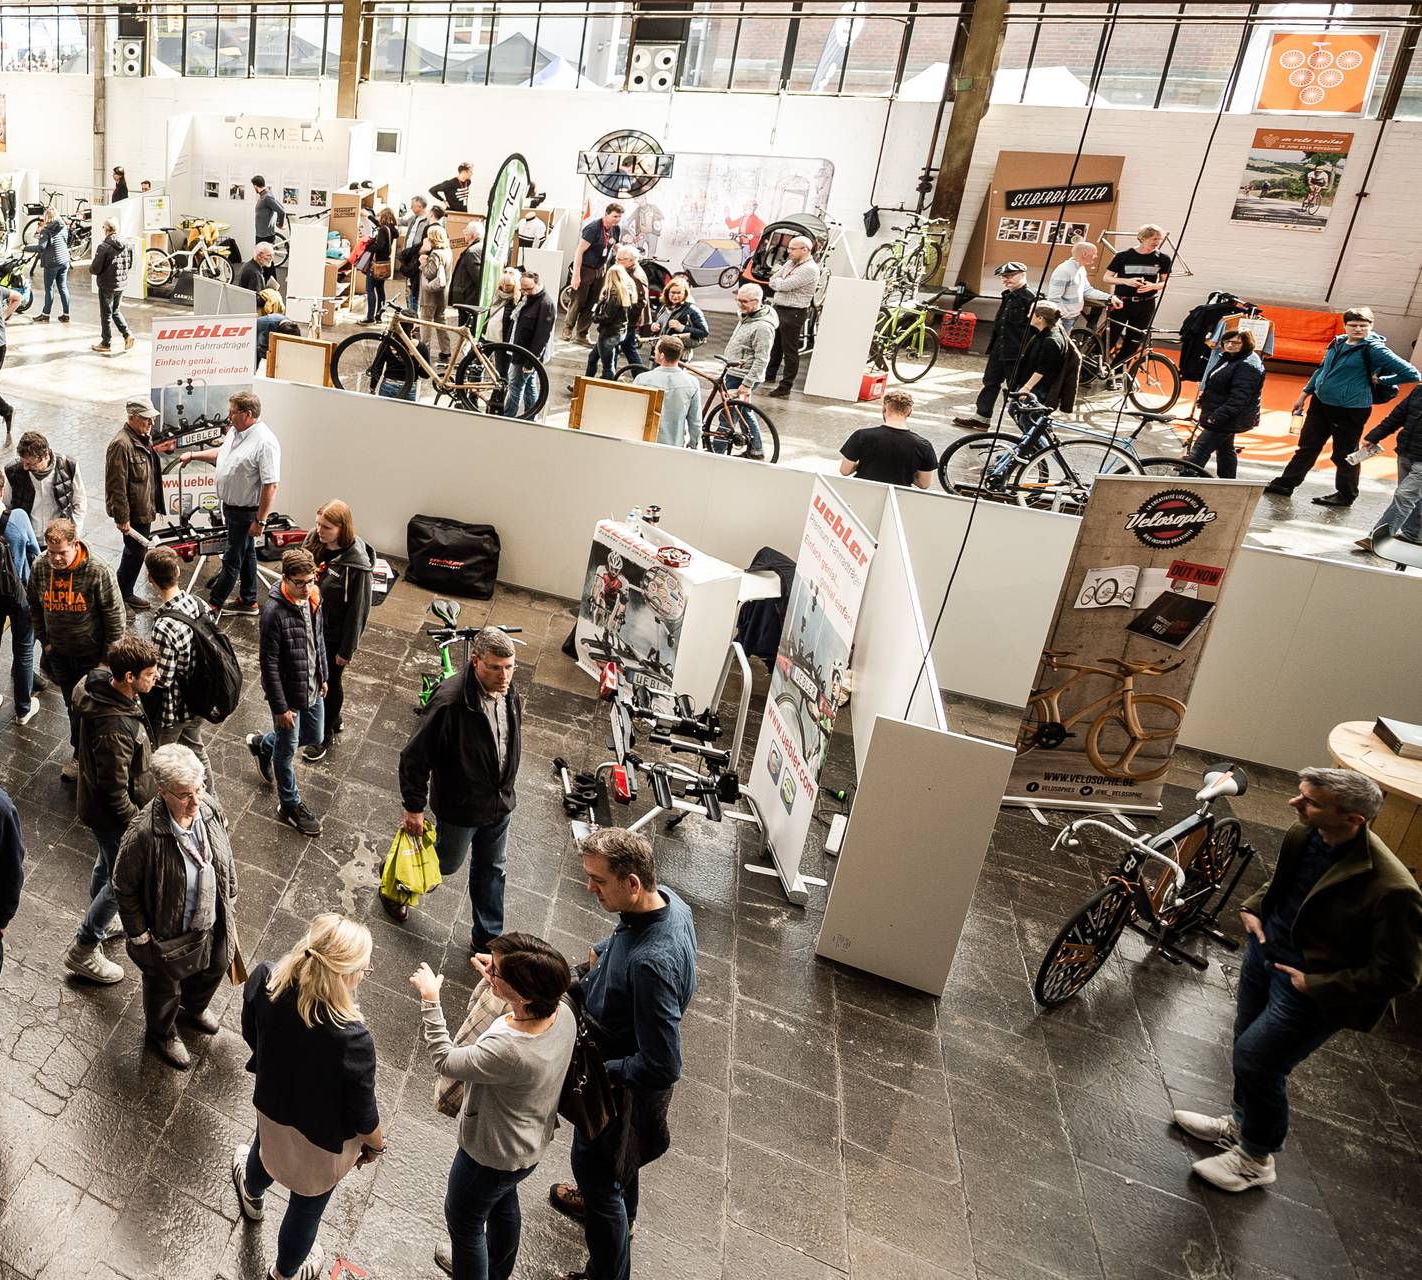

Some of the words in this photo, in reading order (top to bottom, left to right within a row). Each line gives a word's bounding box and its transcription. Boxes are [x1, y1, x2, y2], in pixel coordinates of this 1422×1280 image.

[234, 126, 325, 143] CARMELA
[157, 325, 253, 340] uebler
[156, 344, 192, 352] Premium
[194, 341, 250, 351] Fahrradträger
[188, 358, 220, 367] genial...
[218, 366, 249, 374] einfach
[185, 429, 219, 444] UEBLER
[1125, 507, 1217, 530] Velosophe
[813, 496, 868, 567] uebler
[1170, 564, 1193, 578] OUT
[1194, 569, 1221, 583] NOW
[43, 591, 86, 603] ALPHA
[43, 602, 87, 612] INDUSTRIES
[768, 706, 815, 801] www.uebler.com
[1043, 772, 1139, 787] WWW.VELOSOPHE.BE
